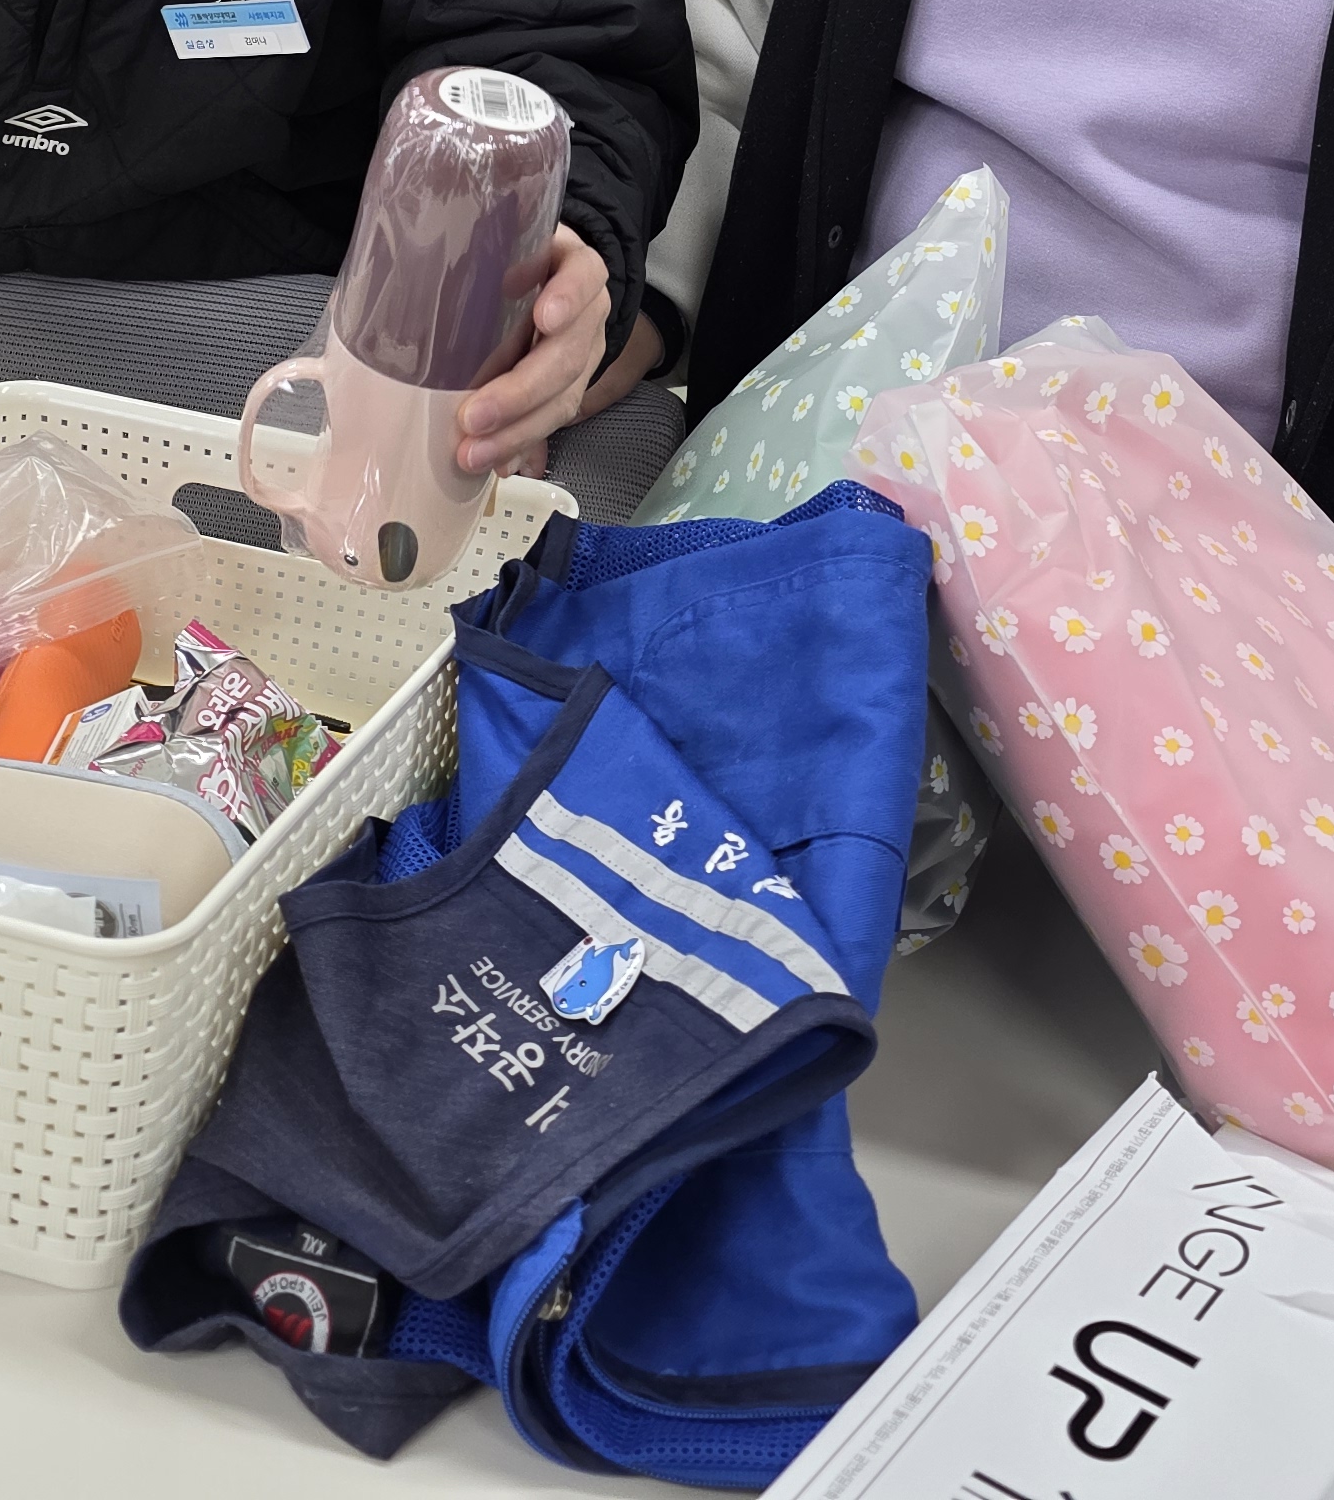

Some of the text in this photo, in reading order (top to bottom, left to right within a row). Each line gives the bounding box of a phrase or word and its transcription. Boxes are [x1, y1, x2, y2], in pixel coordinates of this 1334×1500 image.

[185, 39, 215, 50] 실습생
[2, 134, 70, 156] umbro
[197, 671, 252, 731] 오리온
[469, 955, 562, 1033] SERVICE
[431, 973, 548, 1094] 공작소
[302, 1234, 327, 1256] XXL
[1048, 1318, 1202, 1463] UP
